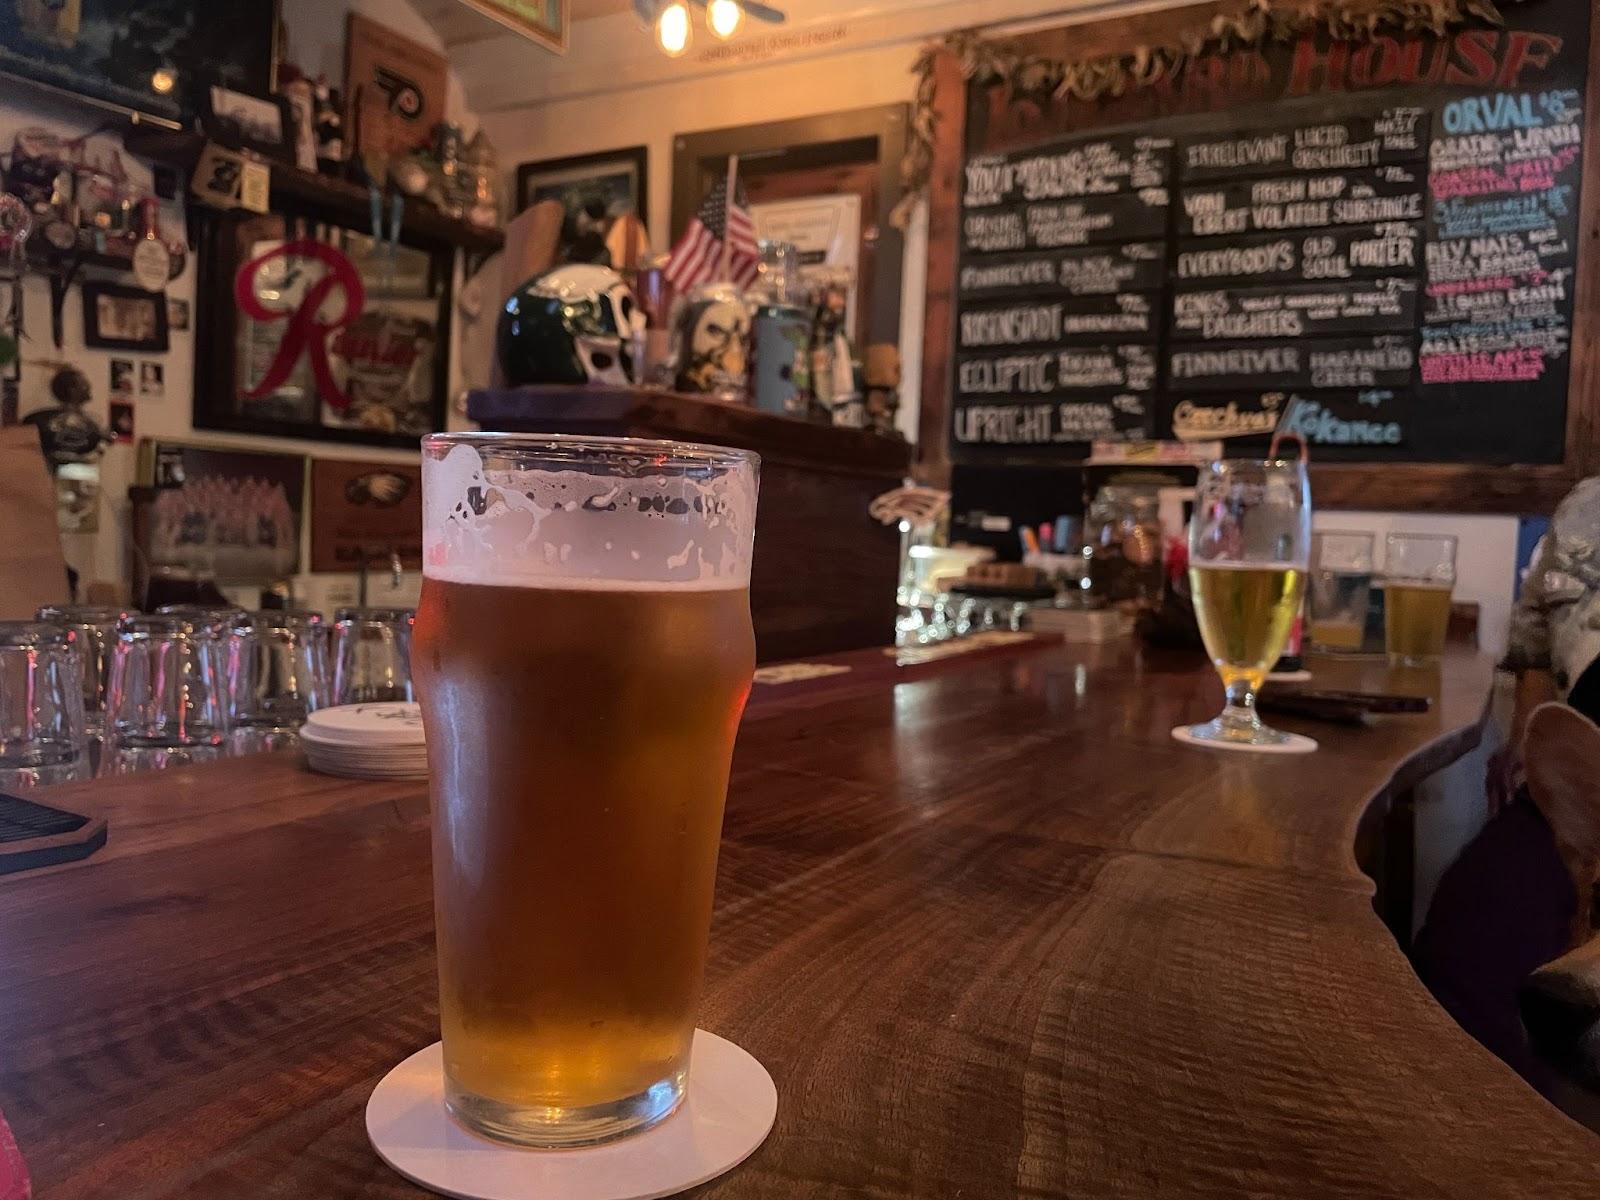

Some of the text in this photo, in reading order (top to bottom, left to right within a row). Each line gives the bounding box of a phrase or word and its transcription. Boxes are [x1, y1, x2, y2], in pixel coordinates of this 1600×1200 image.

[1288, 28, 1563, 96] HOUSE
[1443, 93, 1543, 135] ORVAL
[959, 353, 1056, 394] ECLIPTIC
[1171, 347, 1301, 378] FINNRIVER
[954, 403, 1053, 444] UPRIGHT
